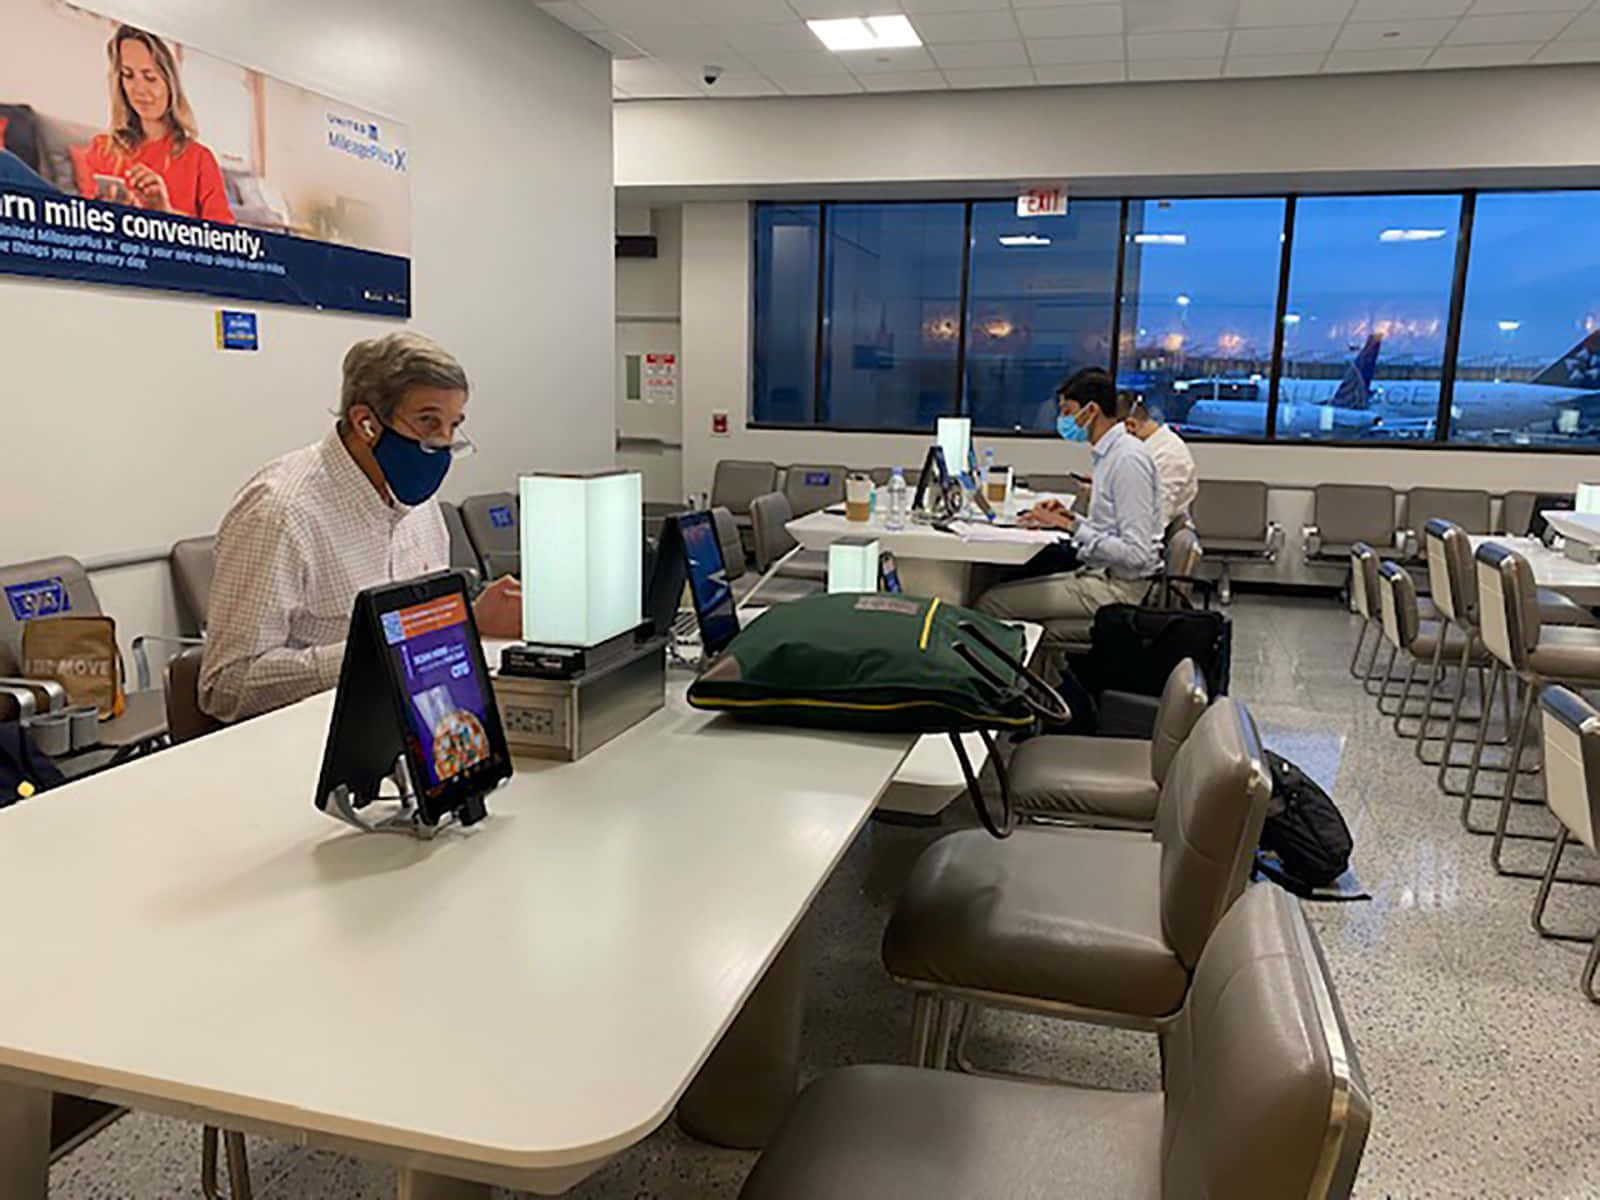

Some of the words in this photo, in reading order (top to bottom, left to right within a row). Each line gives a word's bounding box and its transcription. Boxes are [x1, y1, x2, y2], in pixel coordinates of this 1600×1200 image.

[0, 194, 36, 222] rn
[44, 199, 116, 233] miles
[122, 214, 265, 260] conveniently.
[11, 241, 49, 259] things
[51, 247, 73, 262] you
[95, 253, 125, 268] every
